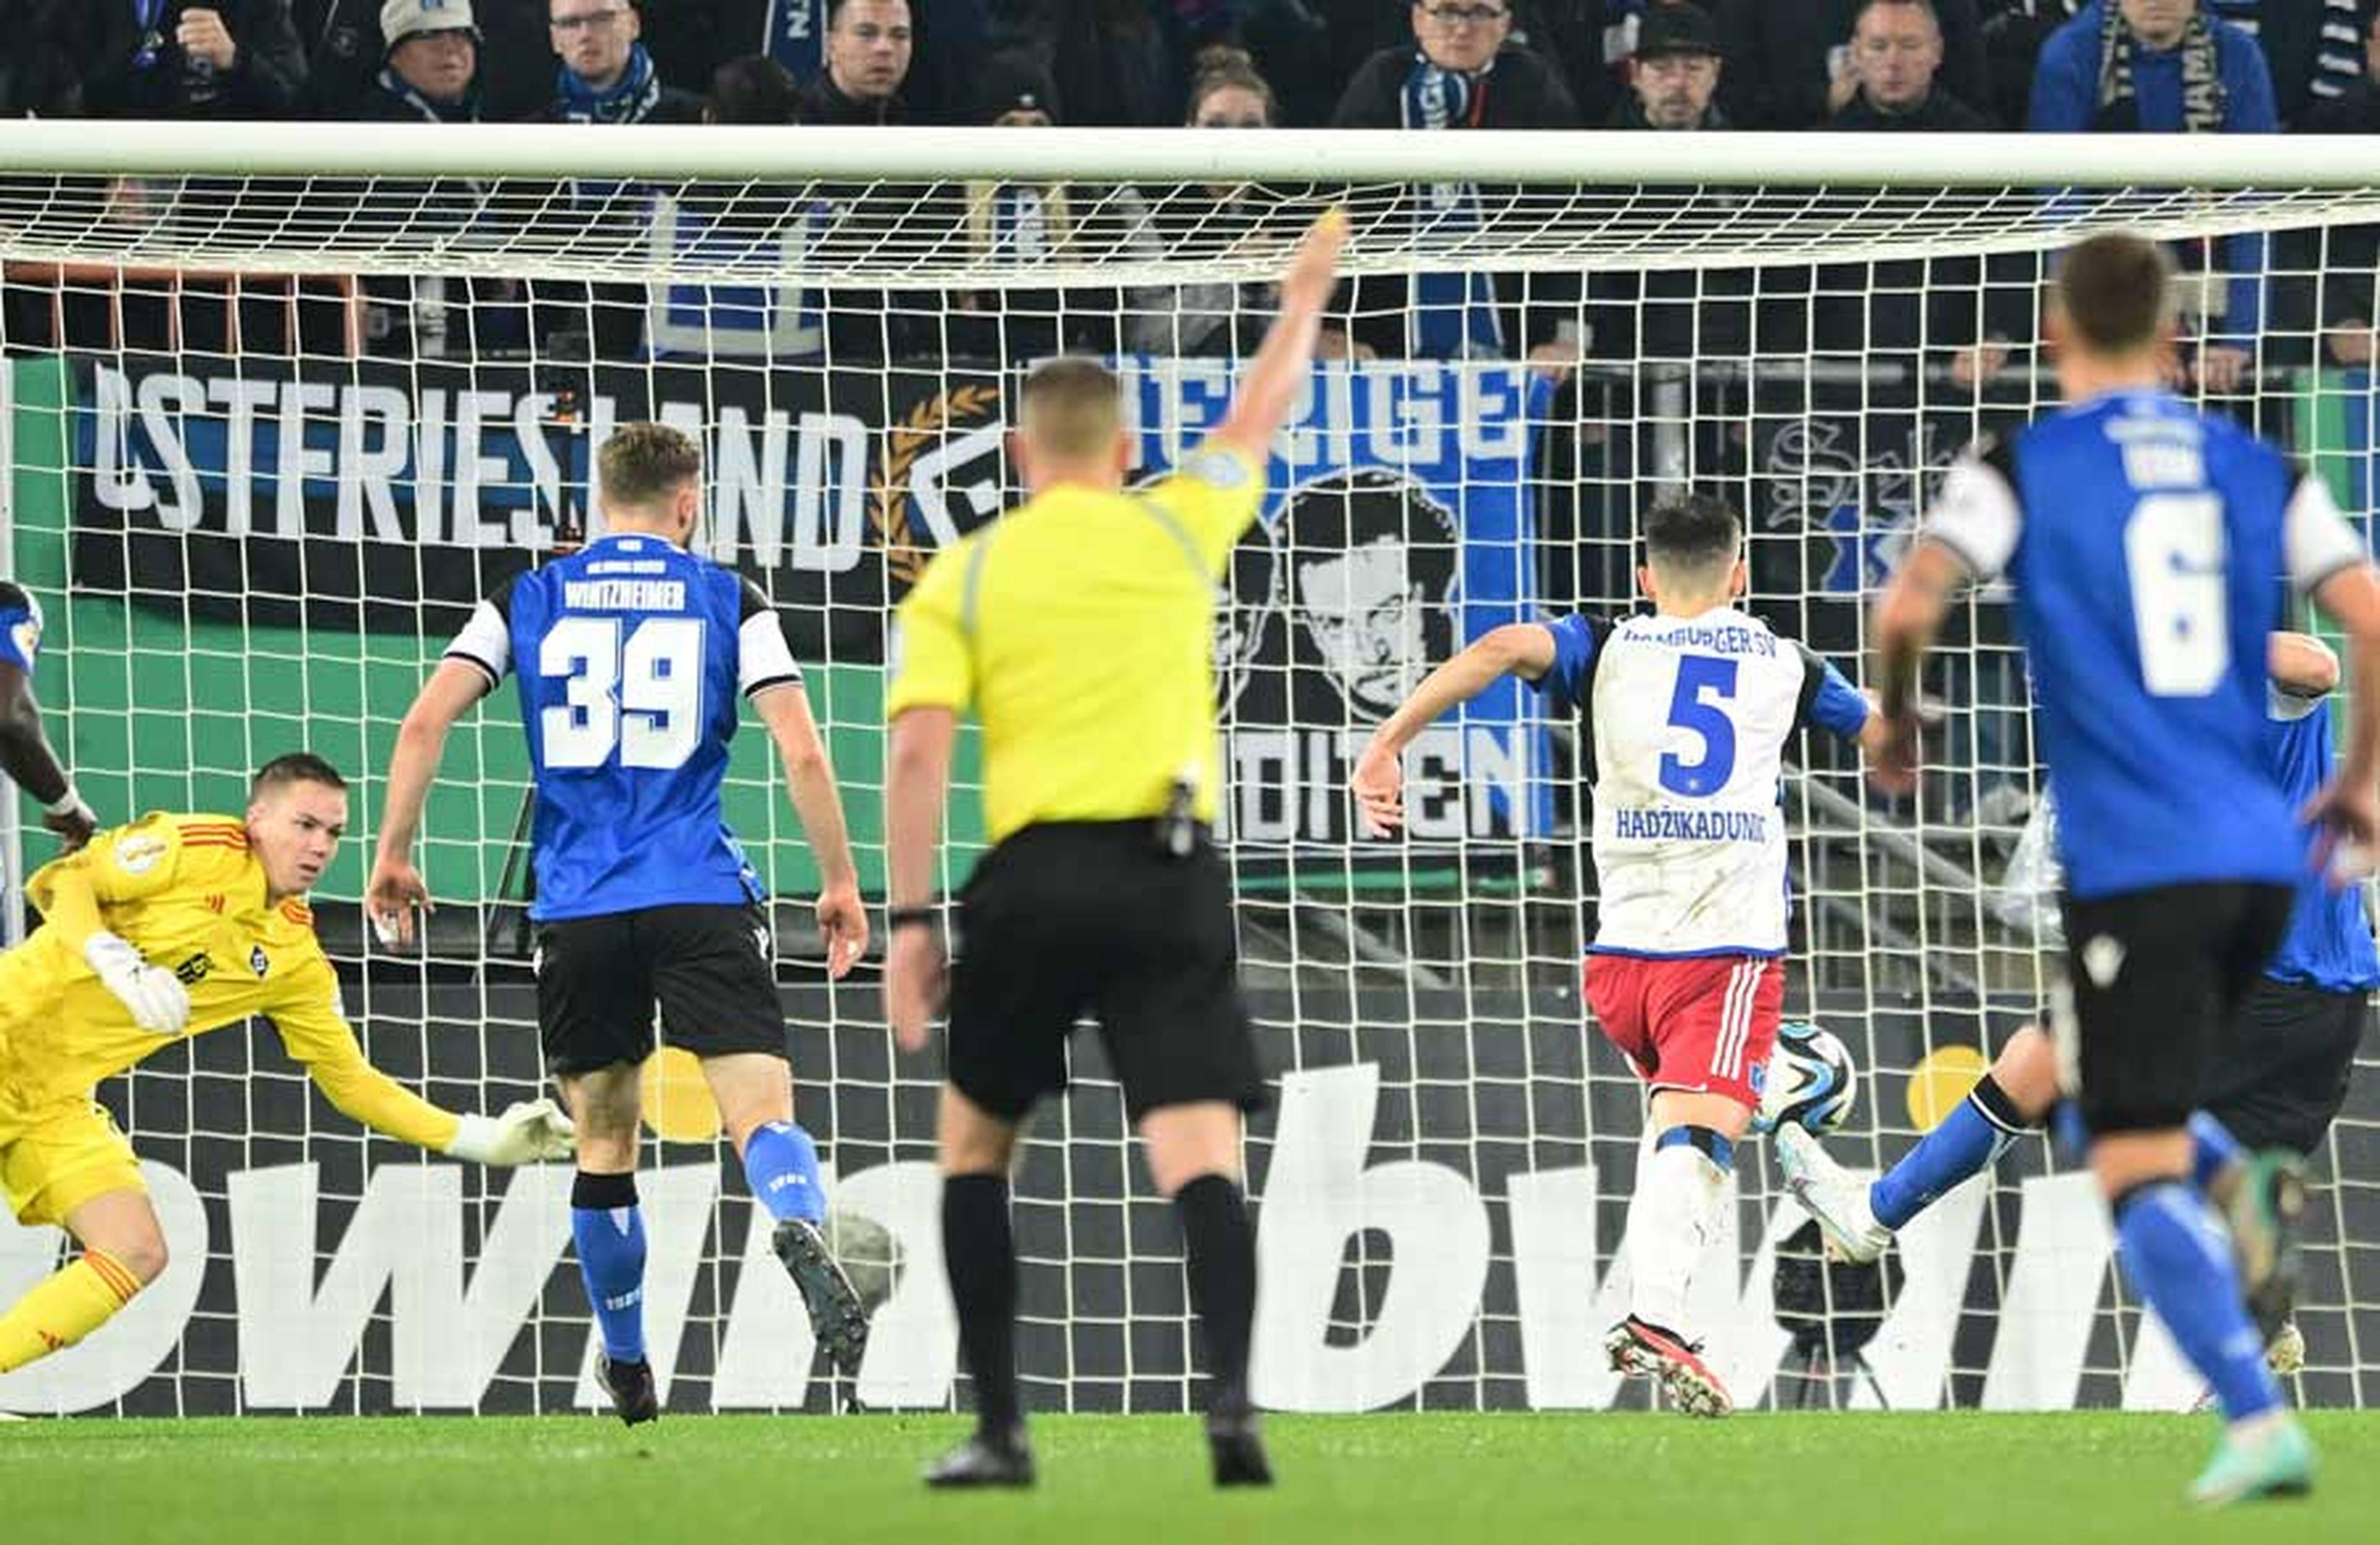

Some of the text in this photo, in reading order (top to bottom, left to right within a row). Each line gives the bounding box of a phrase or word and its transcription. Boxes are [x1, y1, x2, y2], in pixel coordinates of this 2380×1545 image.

[2125, 490, 2229, 698] 6
[540, 617, 707, 769] 39
[1659, 654, 1739, 798] 5
[1212, 728, 1522, 841] DITEN
[1616, 805, 1766, 844] HADŽIKADUN
